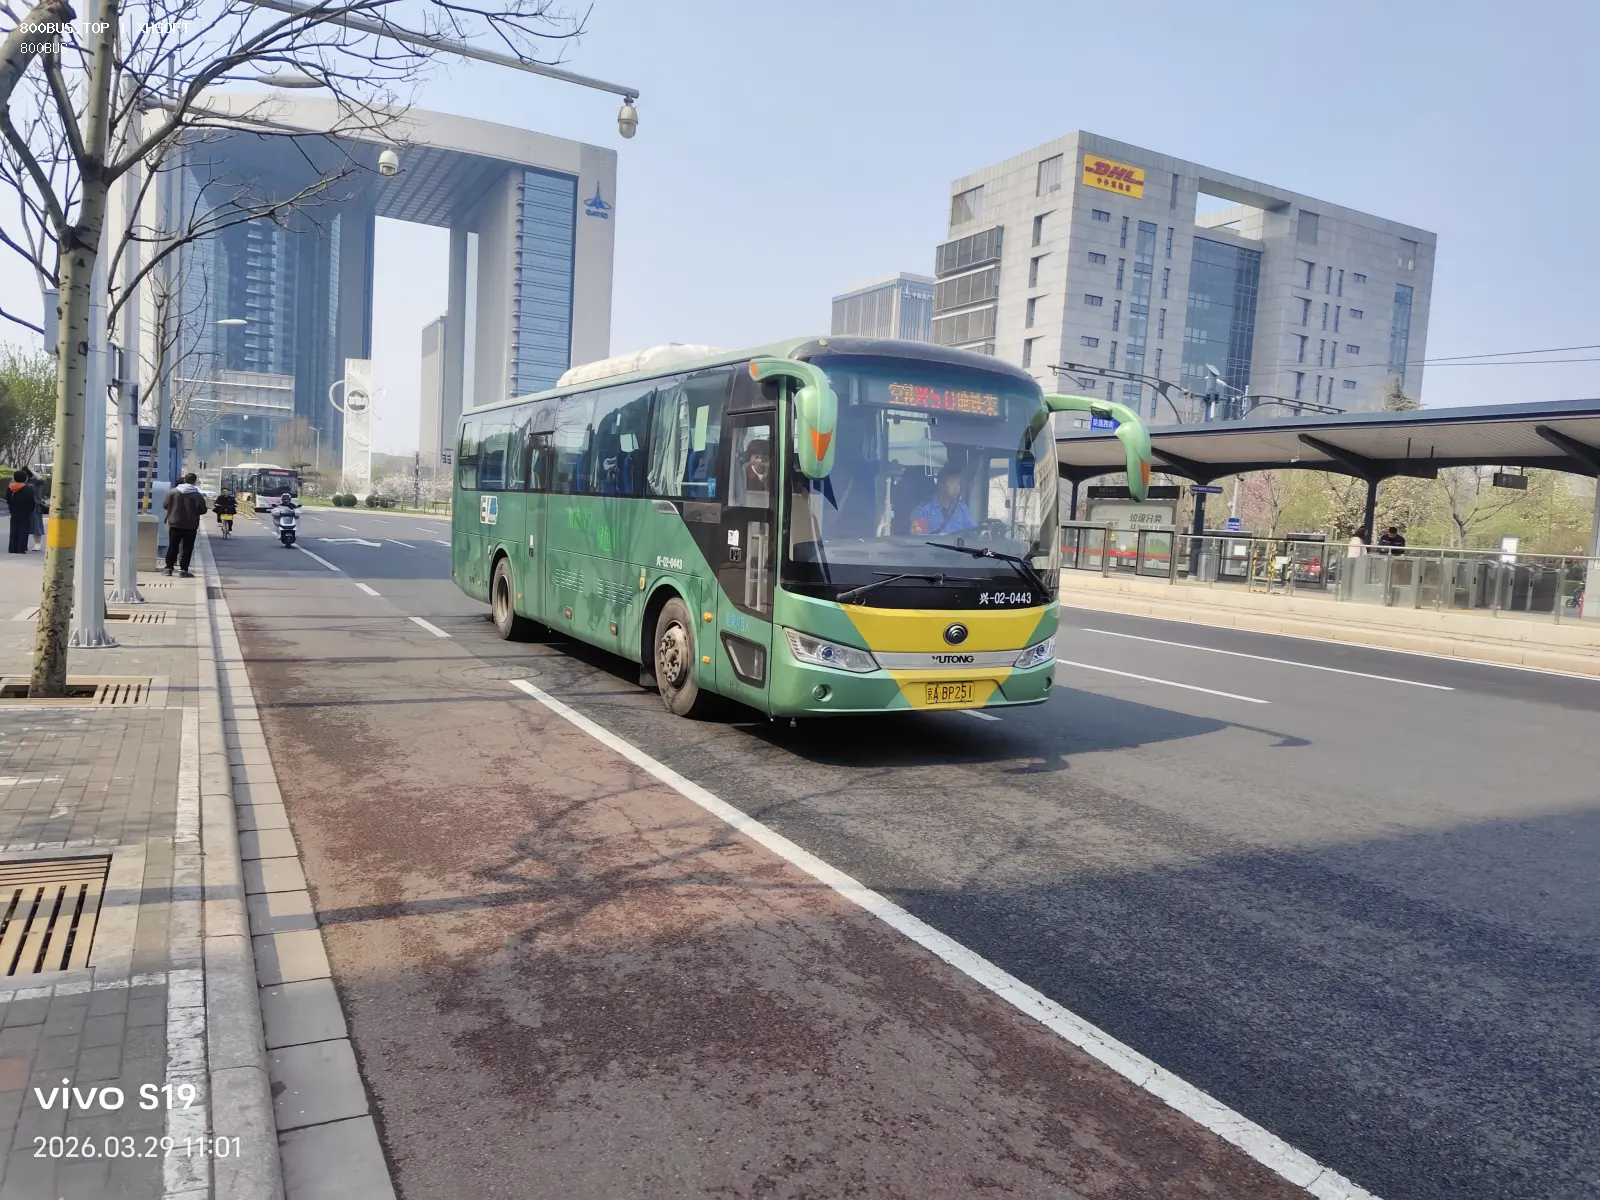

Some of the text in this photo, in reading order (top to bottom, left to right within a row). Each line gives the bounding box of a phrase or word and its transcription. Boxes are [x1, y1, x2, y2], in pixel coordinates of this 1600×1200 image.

[1092, 161, 1141, 183] DHL
[979, 592, 1032, 605] 兴-02-0443
[726, 612, 750, 633] 40人
[931, 655, 975, 664] YUTONG
